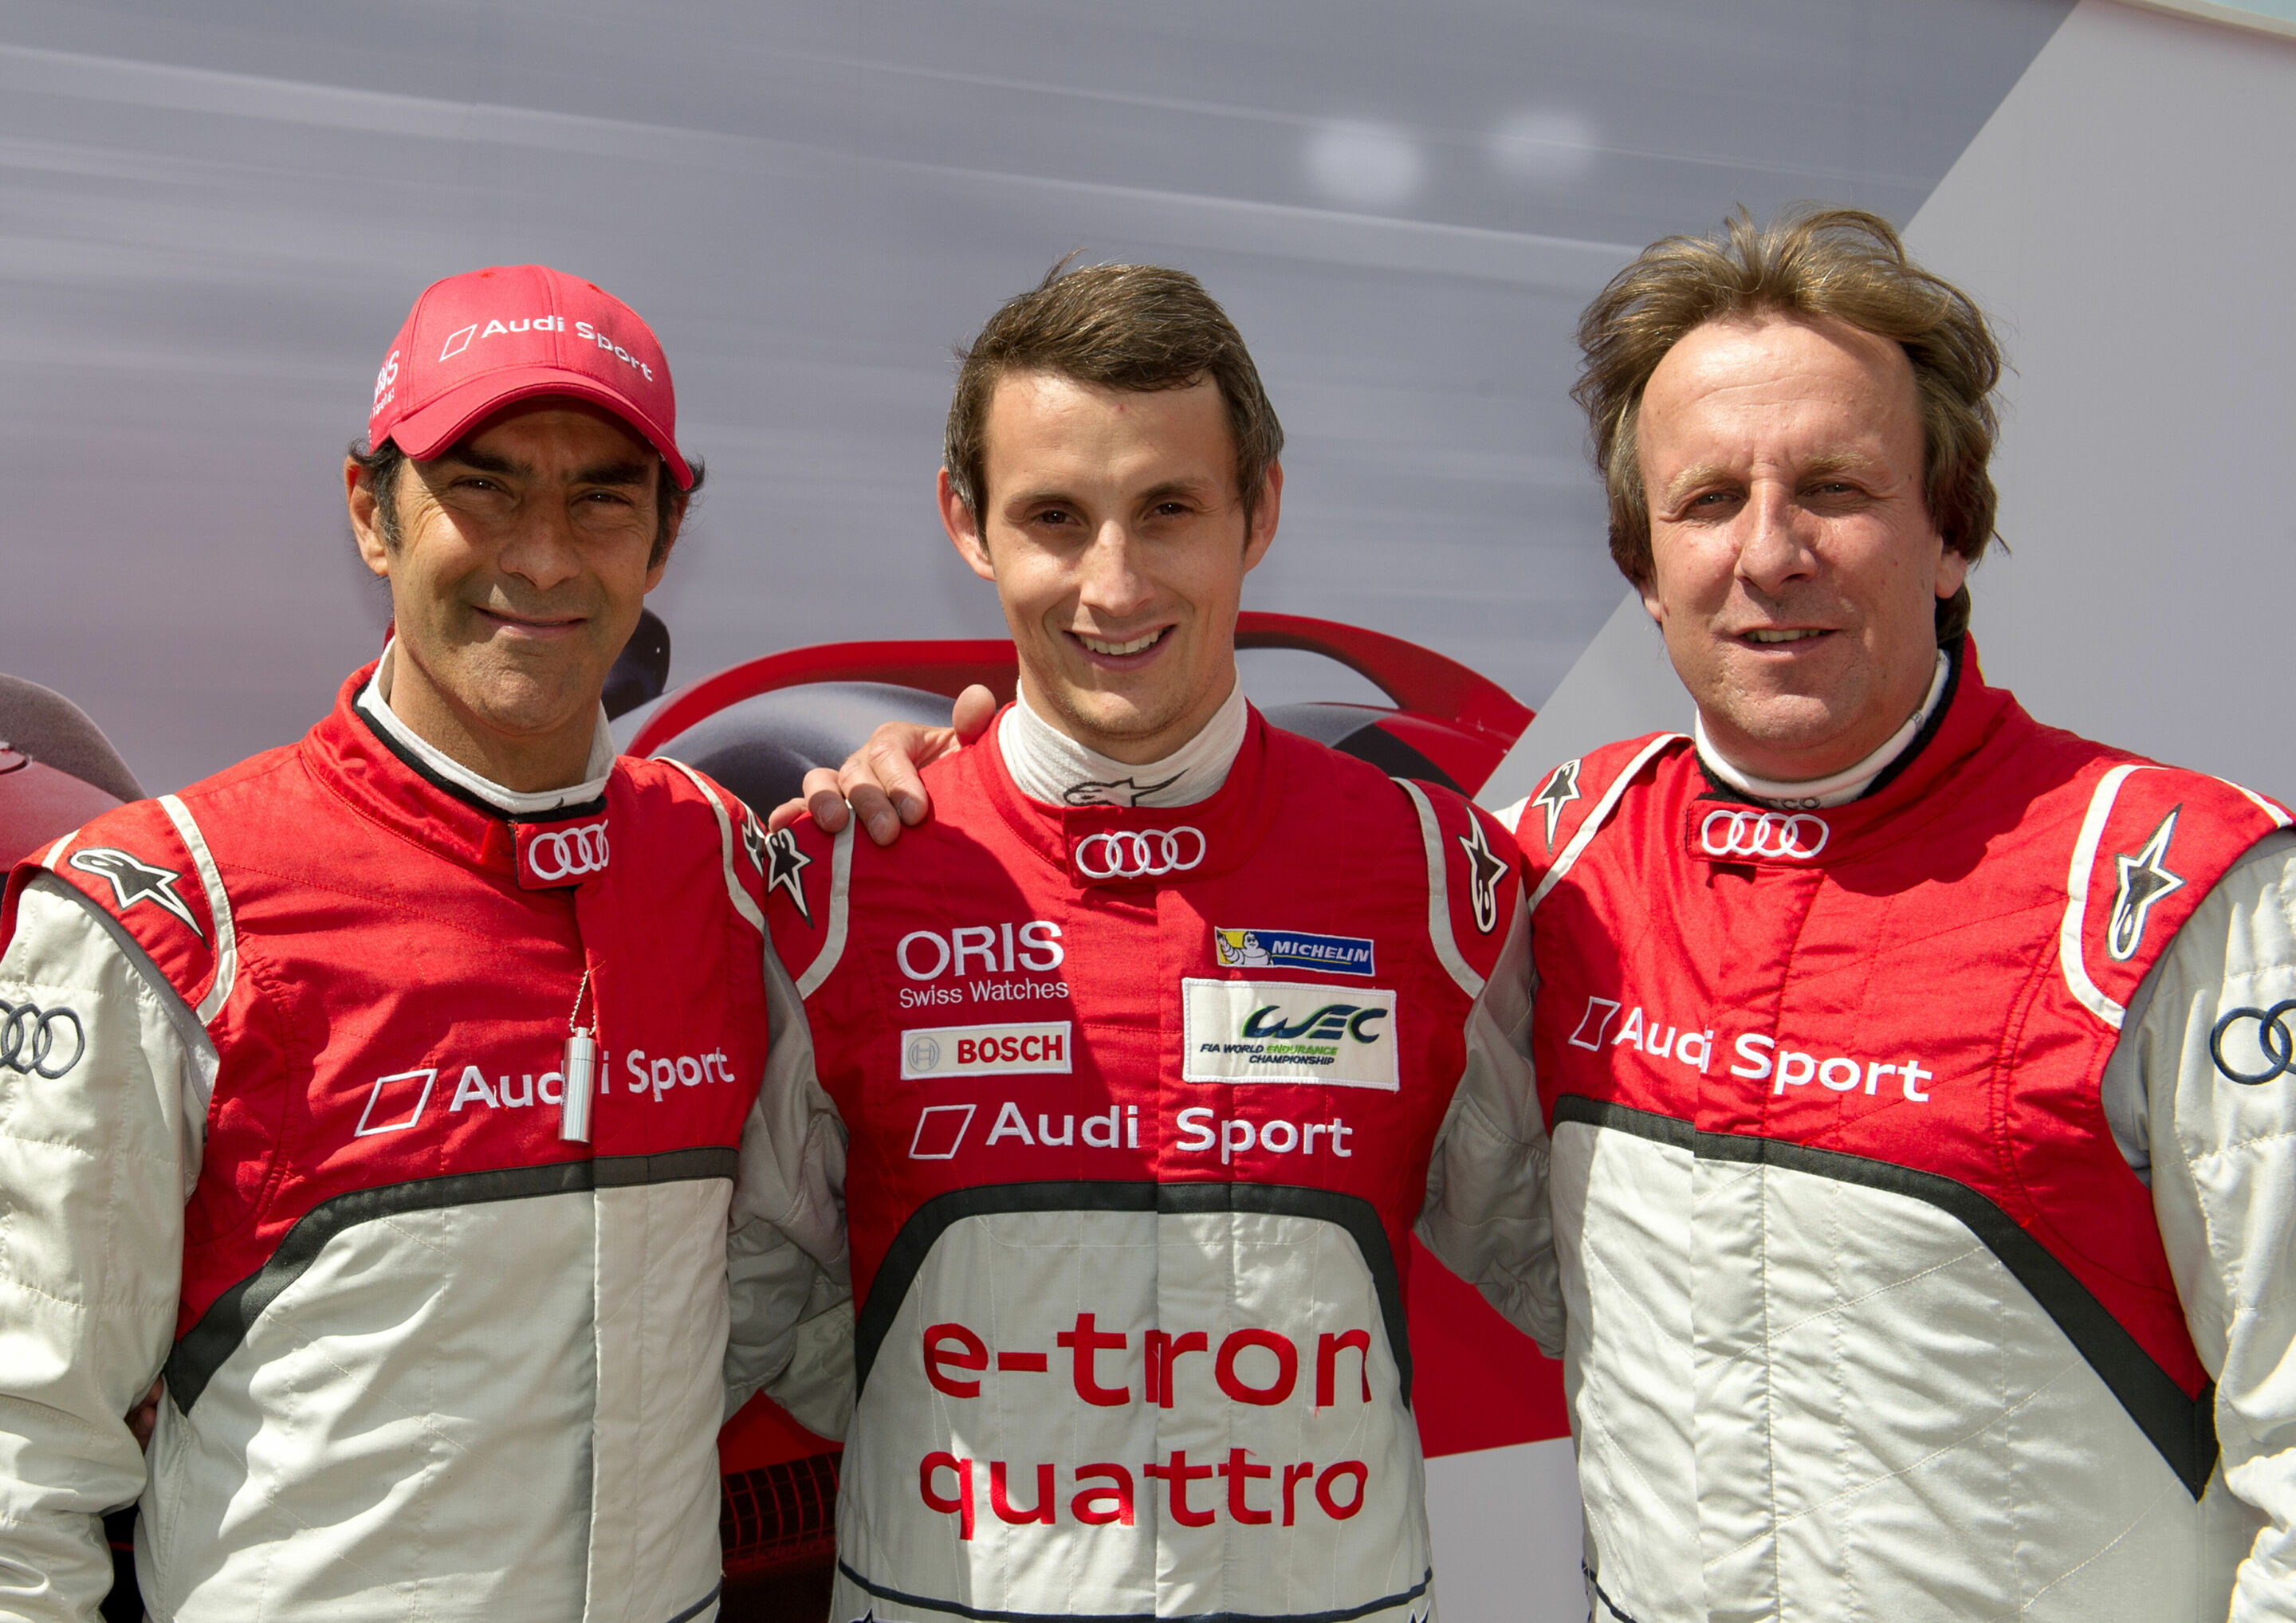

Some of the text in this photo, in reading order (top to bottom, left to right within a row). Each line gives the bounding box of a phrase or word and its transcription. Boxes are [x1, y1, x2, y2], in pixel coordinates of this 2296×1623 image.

[481, 315, 653, 383] Audi Sport
[896, 920, 1064, 981] ORIS
[1272, 940, 1370, 963] MICHELIN
[899, 977, 1070, 1008] Swiss Watches
[957, 1035, 1063, 1064] BOSCH
[1200, 1043, 1339, 1056] FIA WORLD ENDURANCE
[1240, 1004, 1388, 1044] WEC
[626, 1047, 736, 1103] Sport
[1248, 1055, 1335, 1066] CHAMPIONSHIP
[1610, 1006, 1933, 1102] Audi Sport
[985, 1101, 1354, 1165] Audi Sport
[922, 1312, 1372, 1409] e-tron
[919, 1447, 1369, 1541] quattro
